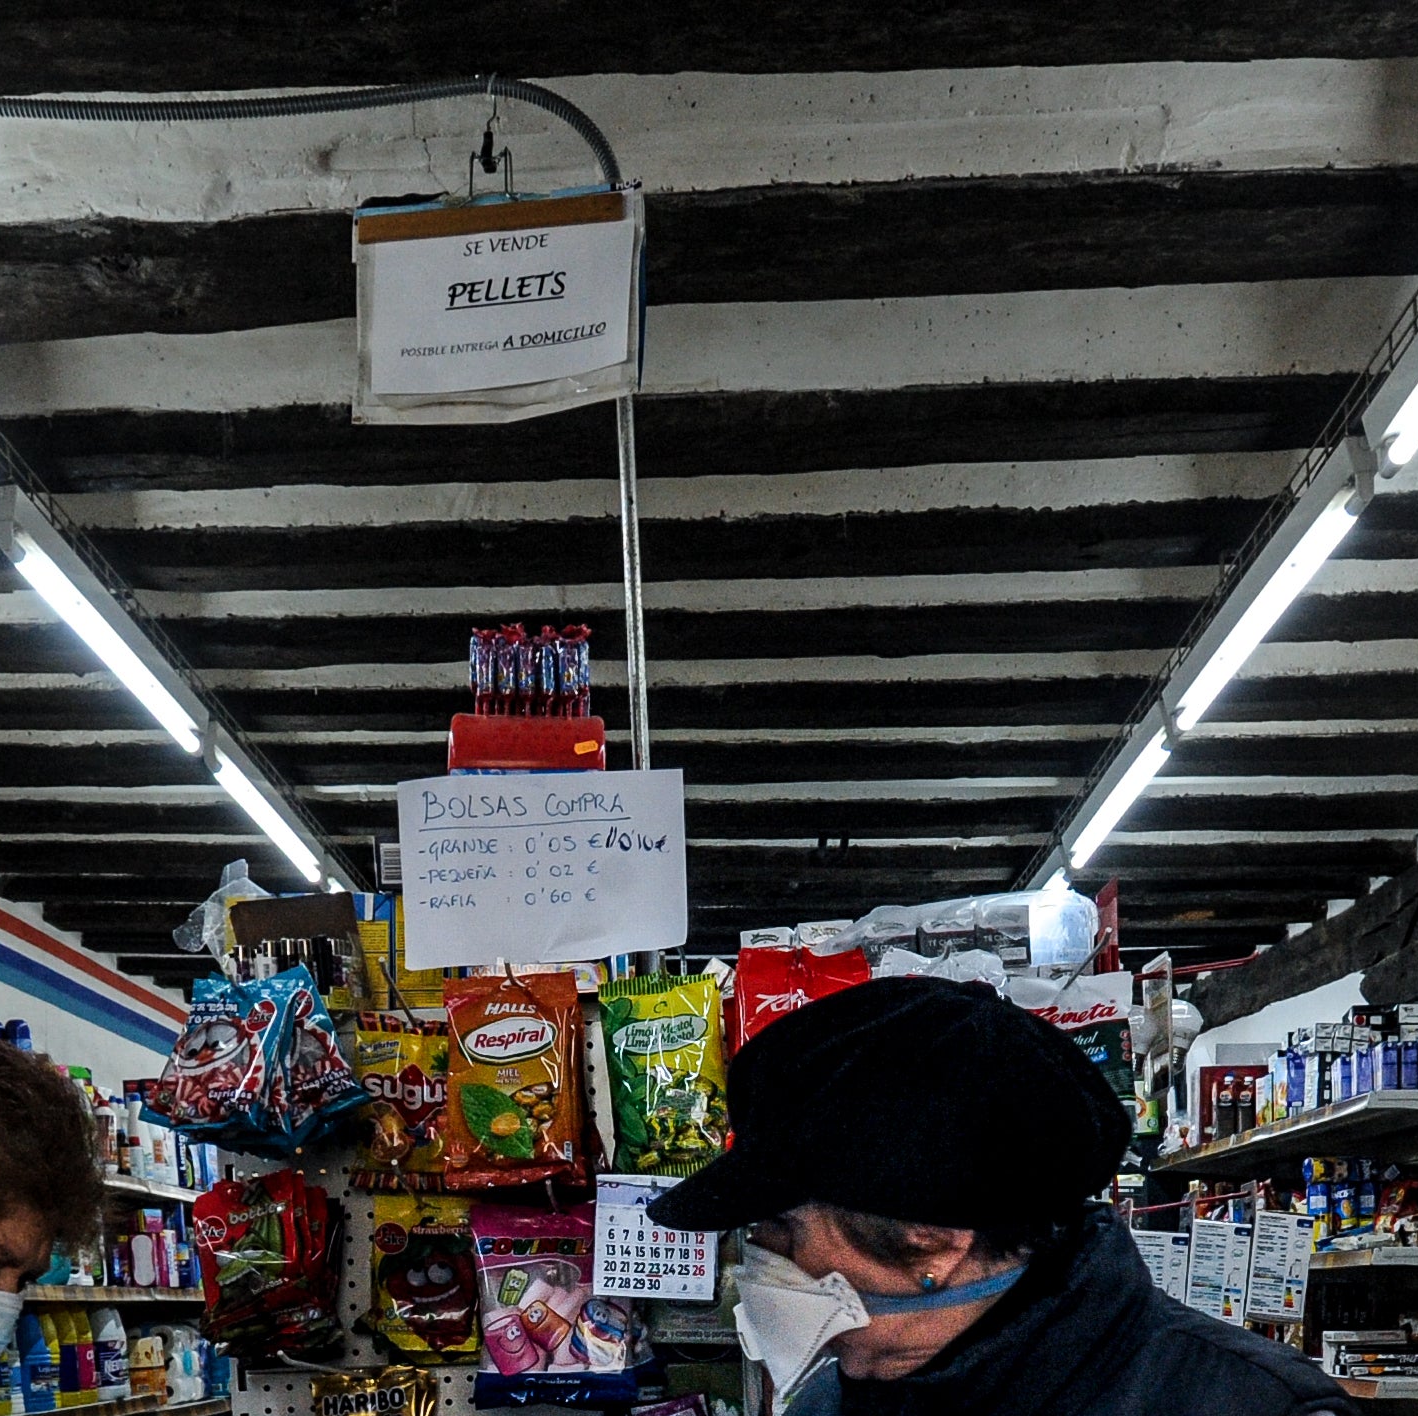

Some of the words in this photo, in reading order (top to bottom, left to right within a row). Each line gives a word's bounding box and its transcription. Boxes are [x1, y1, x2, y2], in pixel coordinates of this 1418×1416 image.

[463, 240, 483, 257] SE
[489, 233, 550, 254] VENDE
[447, 271, 567, 307] PELLETS
[400, 345, 446, 358] POSIBLE
[450, 340, 499, 355] ENTREGA
[503, 335, 514, 349] A
[518, 321, 607, 347] DOMICILIO
[422, 791, 527, 824] BOLSAS
[544, 792, 624, 817] COMPRA
[484, 1003, 537, 1016] HALLS
[474, 1026, 546, 1050] Respiral
[496, 1068, 521, 1078] MIEL
[363, 1074, 448, 1110] sugu
[608, 1228, 615, 1239] 6
[622, 1229, 630, 1240] 7
[637, 1230, 644, 1241] 8
[652, 1231, 659, 1242] 9
[665, 1232, 676, 1243] 10
[679, 1232, 689, 1244] 11
[694, 1233, 705, 1244] 12
[606, 1244, 616, 1256] 13
[620, 1245, 631, 1257] 14
[635, 1246, 646, 1257] 15
[650, 1247, 660, 1258] 16
[664, 1248, 675, 1259] 17
[679, 1248, 690, 1260] 18
[693, 1249, 704, 1260] 19
[603, 1260, 616, 1272] 20
[620, 1261, 630, 1272] 21
[633, 1262, 646, 1274] 22
[648, 1263, 660, 1274] 23
[662, 1264, 675, 1275] 24
[677, 1264, 690, 1276] 25
[692, 1265, 705, 1276] 26
[603, 1276, 616, 1288] 27
[618, 1277, 631, 1288] 28
[632, 1278, 646, 1290] 29
[647, 1278, 661, 1290] 30
[323, 1387, 405, 1416] HARIBO
